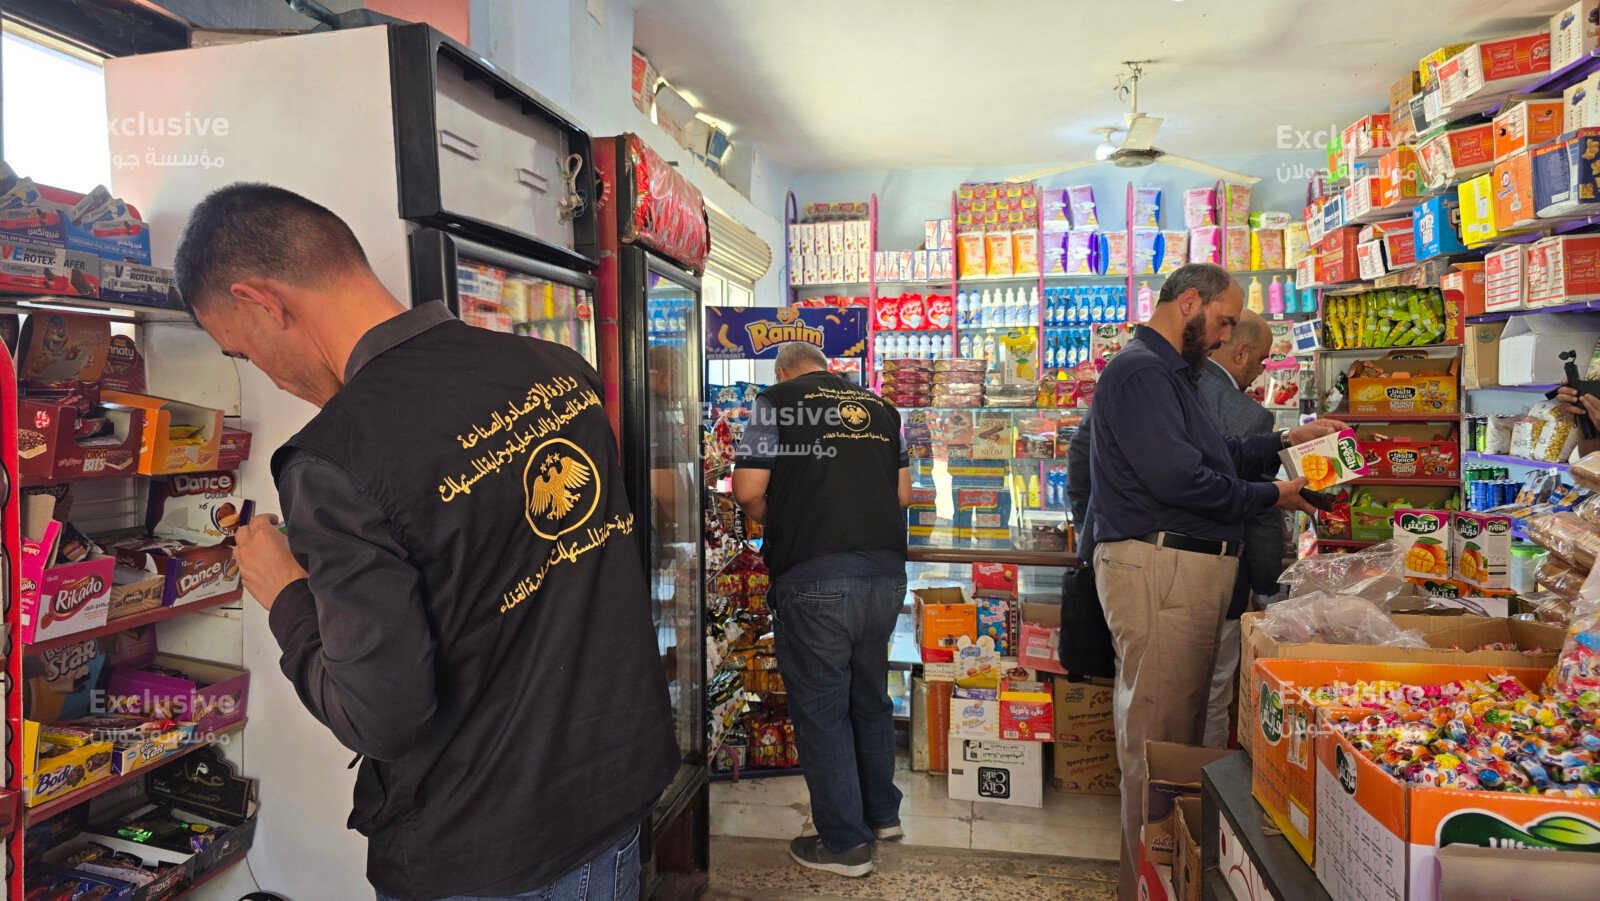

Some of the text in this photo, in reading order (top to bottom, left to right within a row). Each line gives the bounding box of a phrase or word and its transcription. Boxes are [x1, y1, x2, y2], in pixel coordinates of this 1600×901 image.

[749, 320, 823, 353] Ranim
[174, 475, 232, 492] Dance
[438, 458, 490, 502] المستهلك
[1403, 519, 1436, 532] فريش
[550, 528, 602, 566] المستهلك
[180, 561, 222, 592] Dance
[55, 576, 102, 612] Rikado
[35, 763, 73, 796] Bodi
[982, 781, 1006, 794] City
